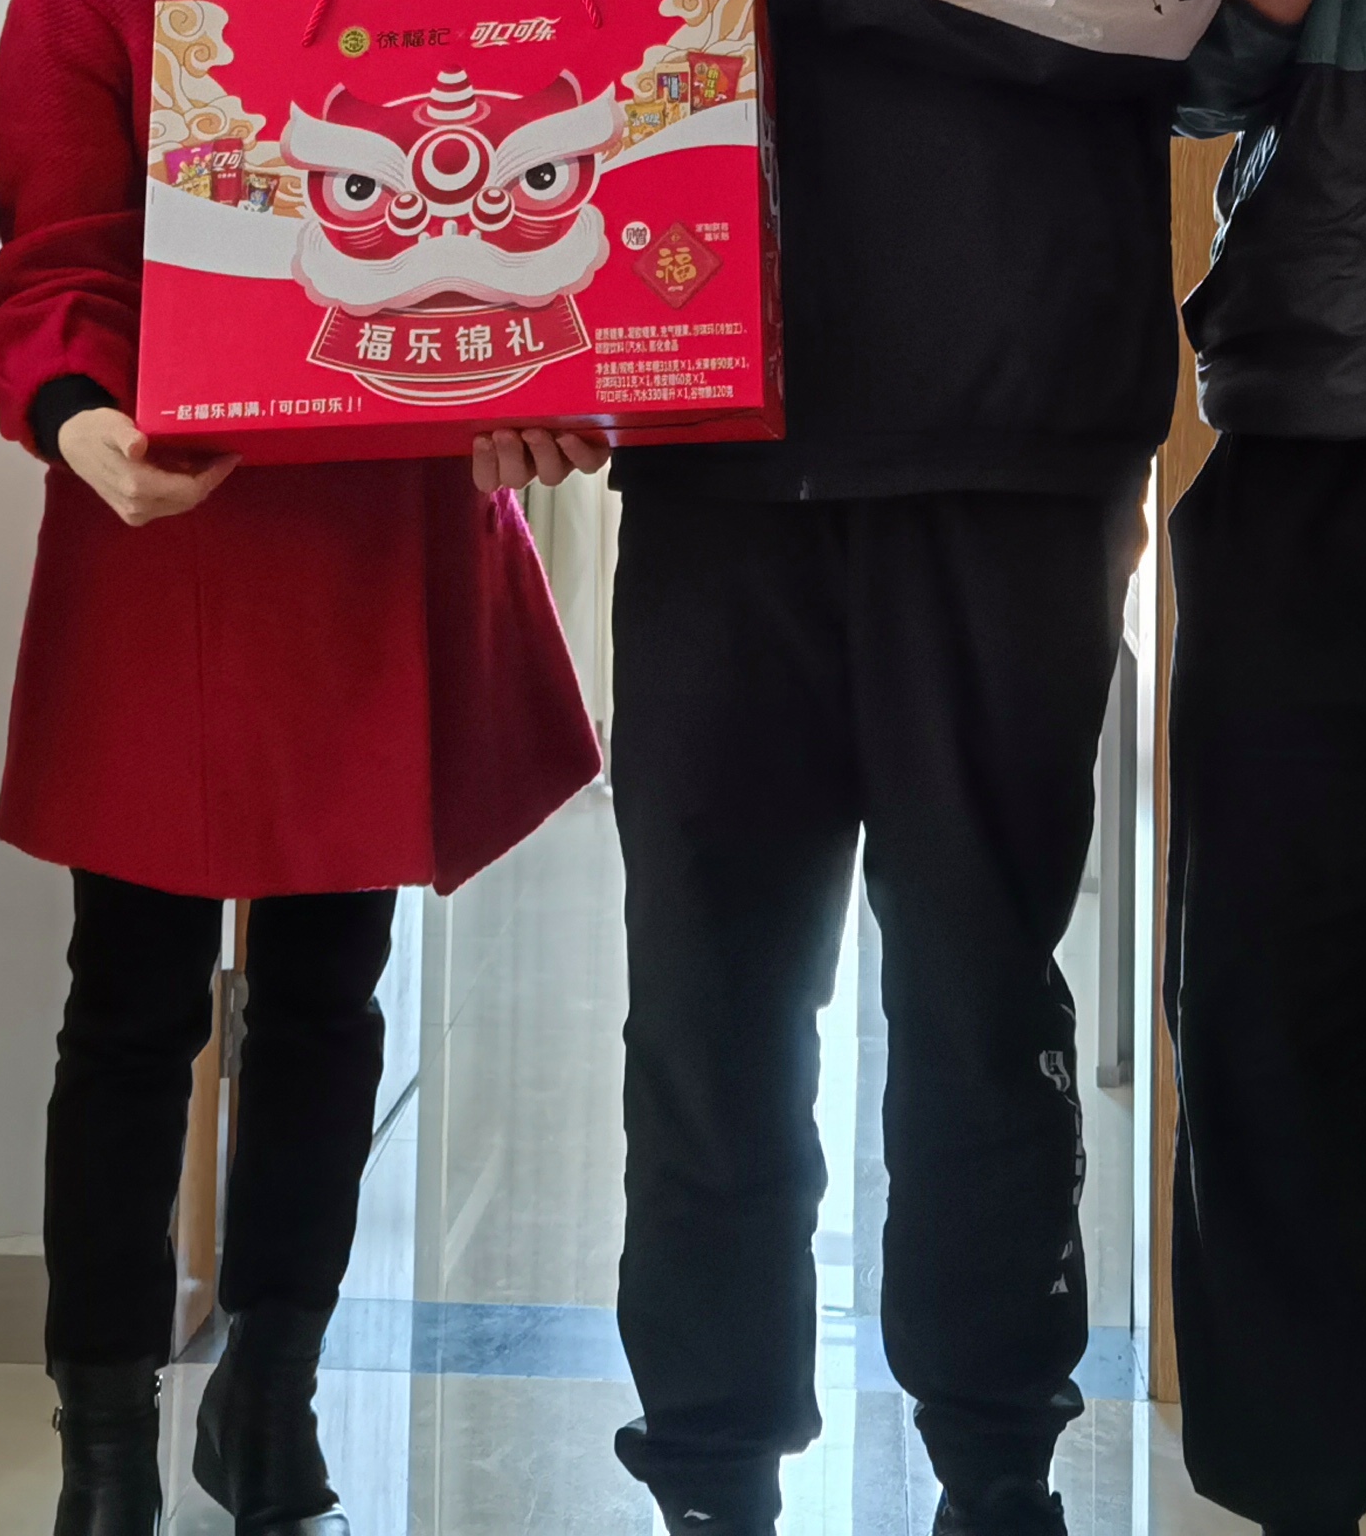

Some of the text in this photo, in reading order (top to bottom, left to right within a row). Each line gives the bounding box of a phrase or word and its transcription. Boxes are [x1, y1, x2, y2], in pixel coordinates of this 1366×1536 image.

[376, 27, 451, 50] 徐福記
[469, 16, 562, 49] 可口可乐
[625, 227, 648, 247] 赠
[655, 246, 697, 284] 福
[355, 316, 544, 364] 福乐锦礼
